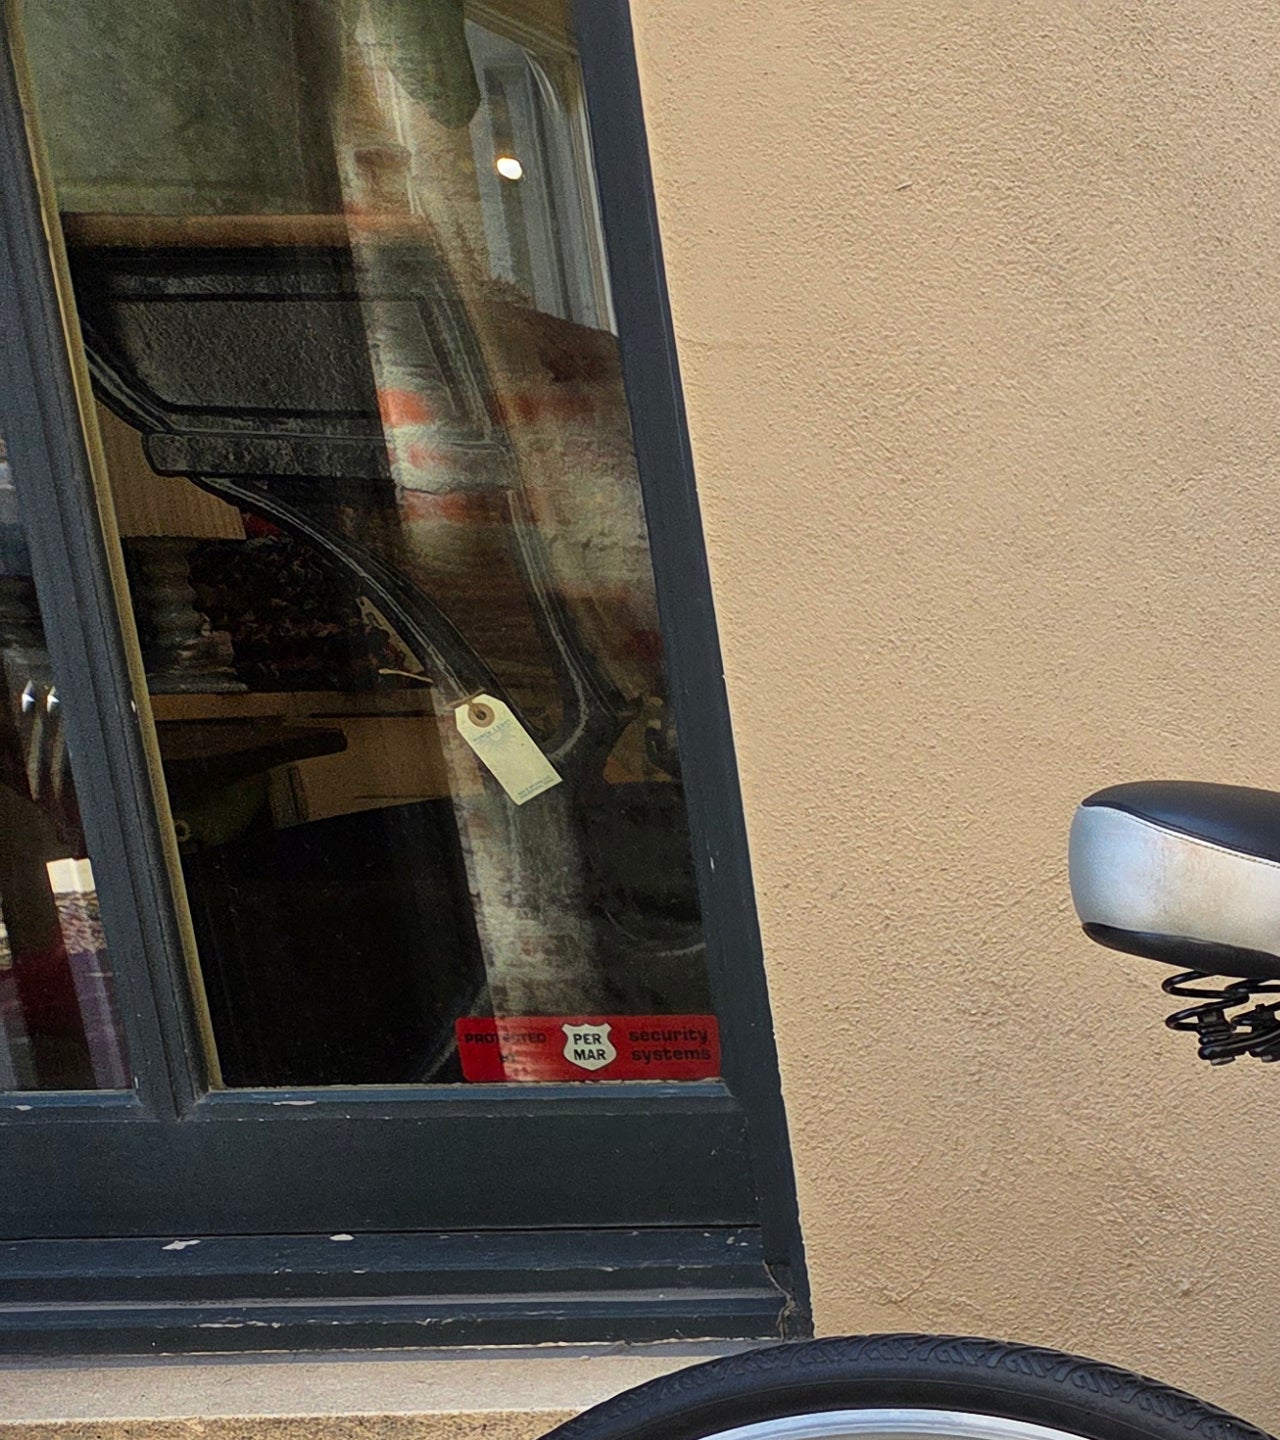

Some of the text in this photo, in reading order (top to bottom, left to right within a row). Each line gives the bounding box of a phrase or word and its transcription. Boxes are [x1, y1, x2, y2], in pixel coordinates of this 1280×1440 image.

[573, 1033, 602, 1045] PER
[628, 1028, 708, 1044] security
[574, 1049, 607, 1061] MAR
[632, 1049, 711, 1065] systems
